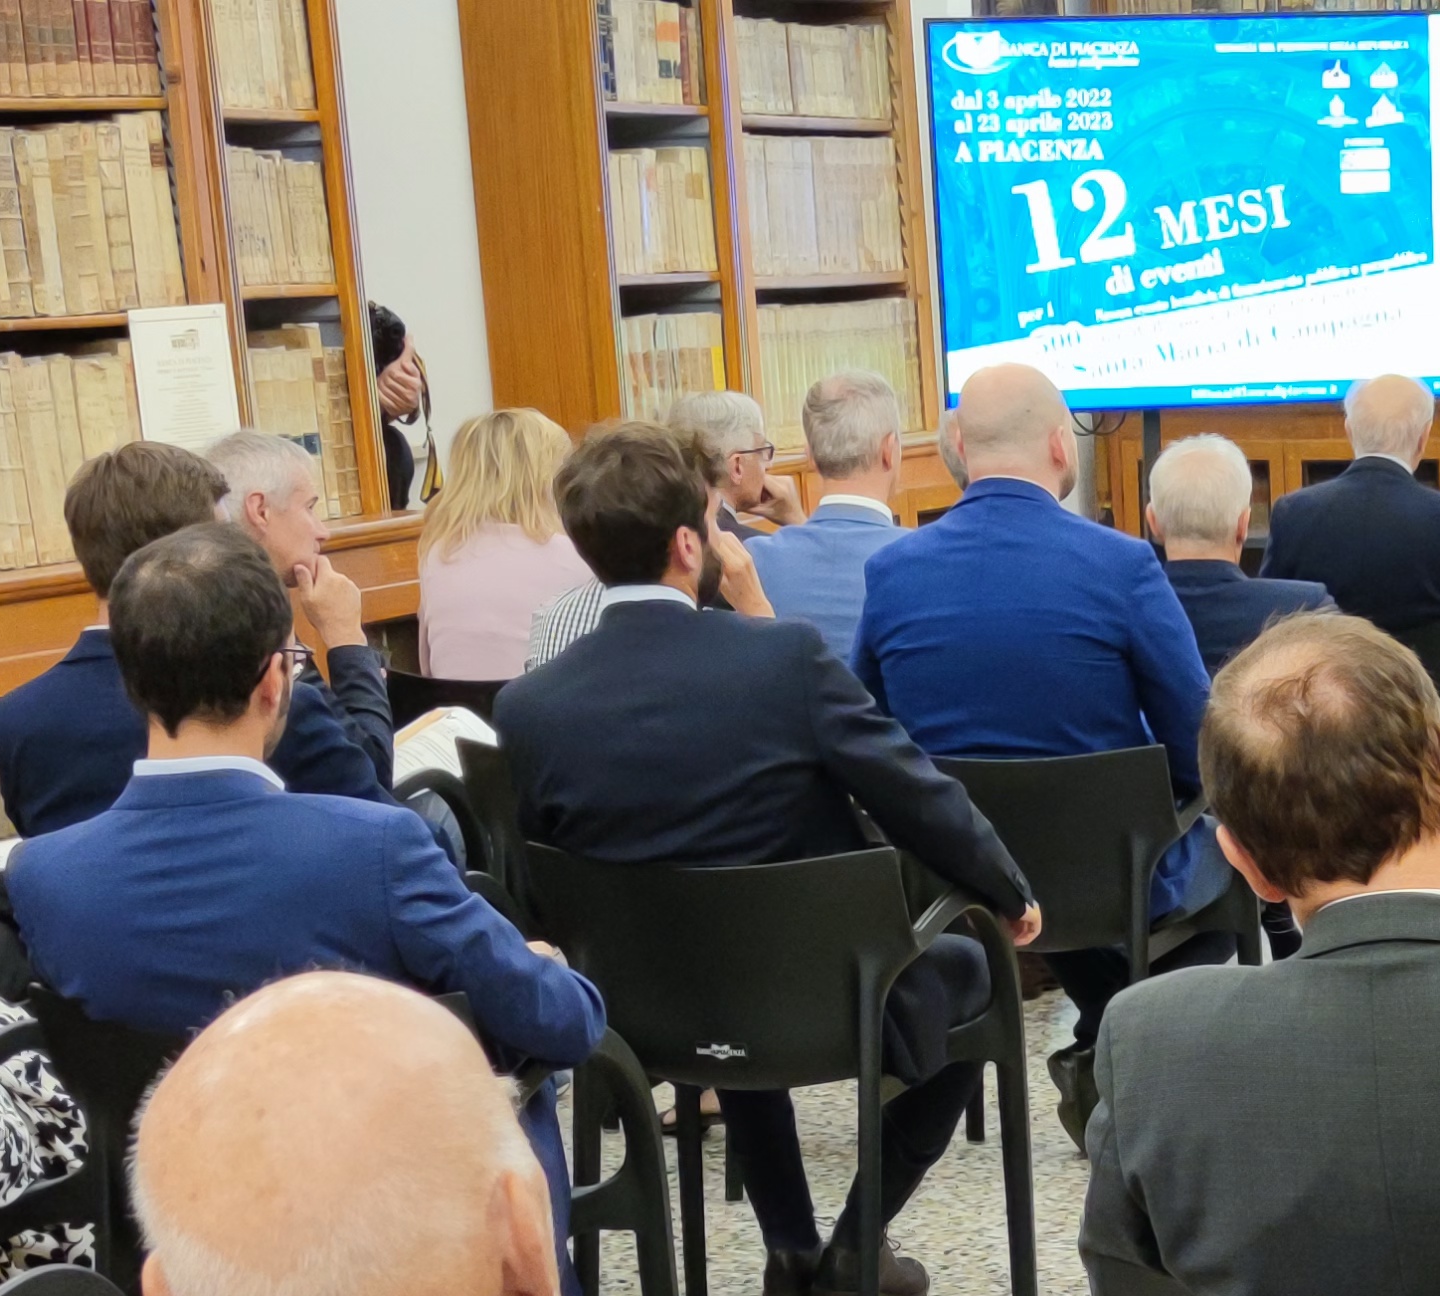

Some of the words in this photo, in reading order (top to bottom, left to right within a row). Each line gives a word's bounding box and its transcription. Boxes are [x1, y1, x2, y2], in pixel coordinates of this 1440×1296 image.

[1050, 42, 1068, 57] DI
[1070, 41, 1140, 56] PIACENZA
[951, 88, 983, 110] dal
[986, 89, 1000, 110] 3
[1004, 87, 1062, 114] aprile
[1065, 88, 1112, 109] 2022
[954, 112, 973, 134] al
[977, 113, 1001, 132] 23
[1005, 111, 1063, 138] aprile
[1067, 111, 1114, 131] 2023
[954, 141, 973, 163] A
[978, 138, 1105, 162] PIACENZA
[1011, 168, 1136, 274] 12
[1154, 184, 1291, 249] MESI
[1105, 264, 1135, 296] di
[1140, 247, 1225, 289] eventi
